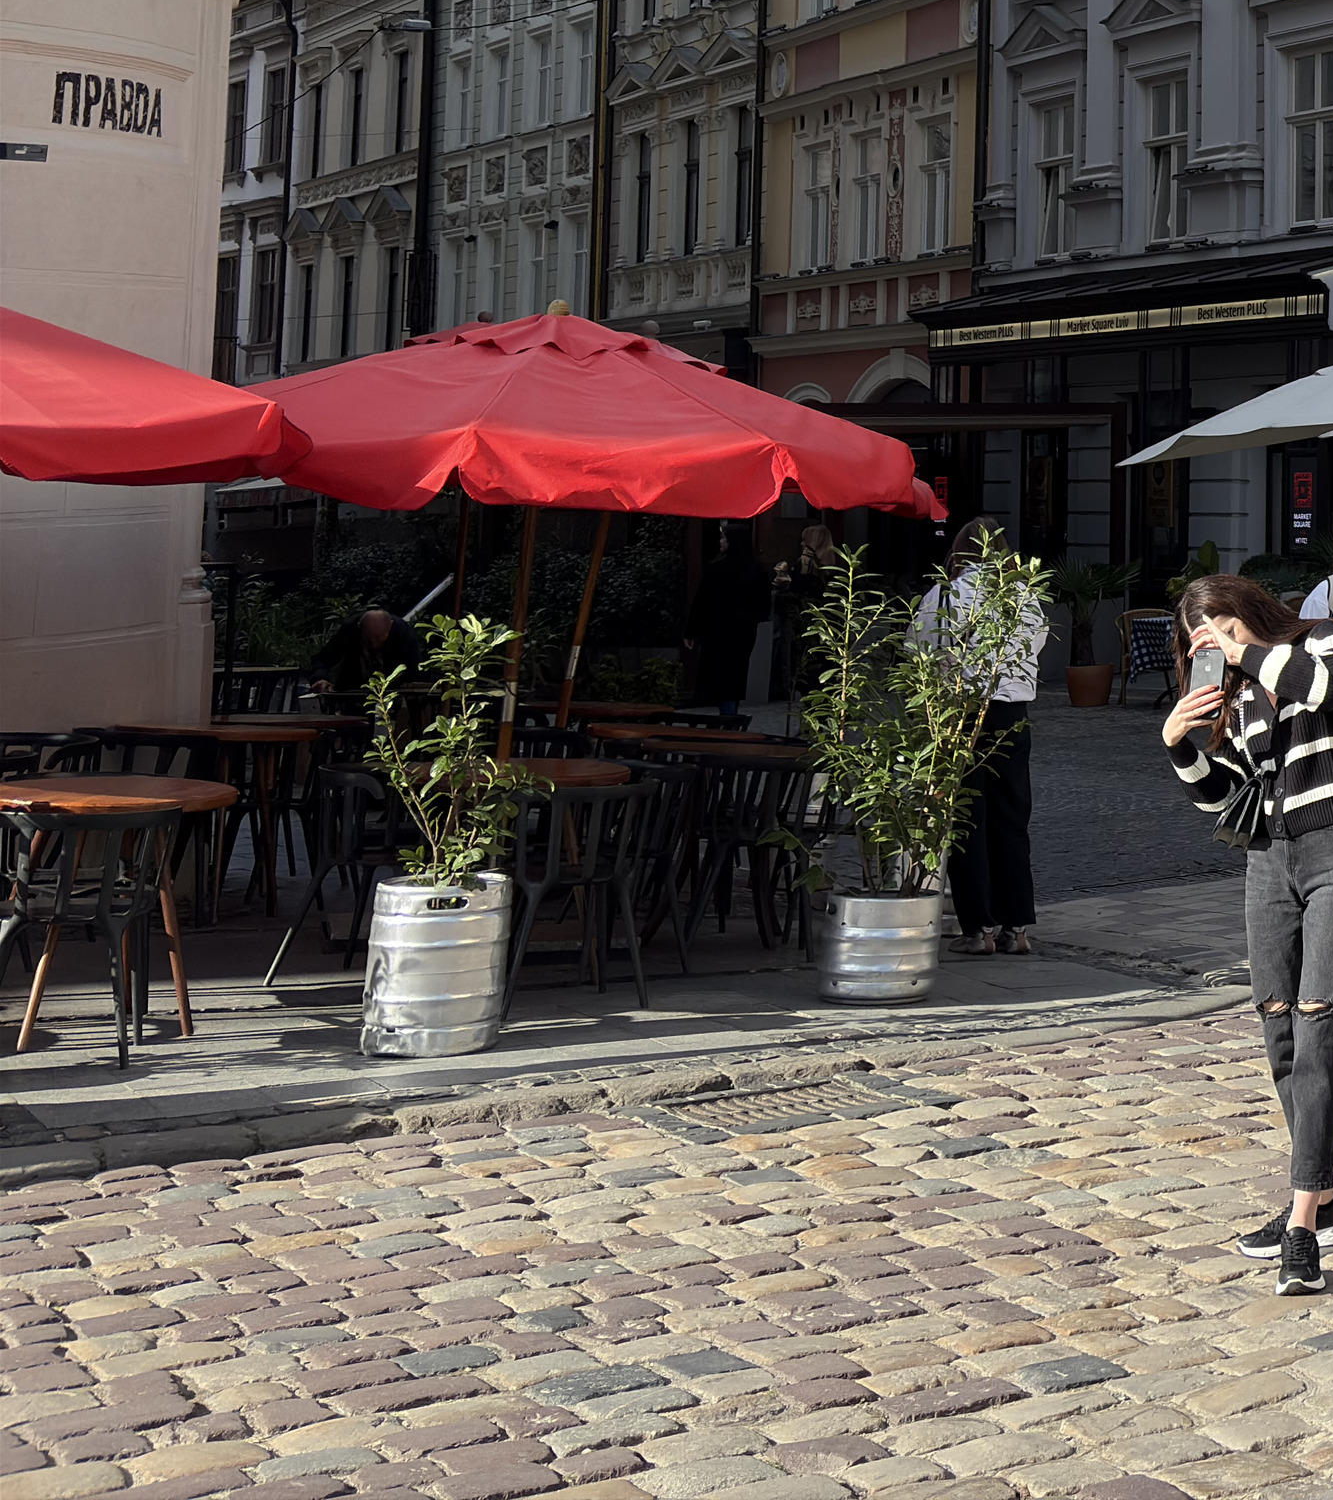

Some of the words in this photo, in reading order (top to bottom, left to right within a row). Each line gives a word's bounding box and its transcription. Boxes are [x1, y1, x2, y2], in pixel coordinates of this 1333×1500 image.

[1197, 308, 1214, 320] Best
[1215, 305, 1245, 318] Western
[1247, 301, 1267, 316] PLUS
[1067, 319, 1091, 333] Market
[1091, 318, 1114, 332] Square
[1115, 315, 1129, 329] Lviv
[959, 330, 972, 342] Best
[973, 327, 997, 340] Western
[998, 325, 1013, 338] PLUS
